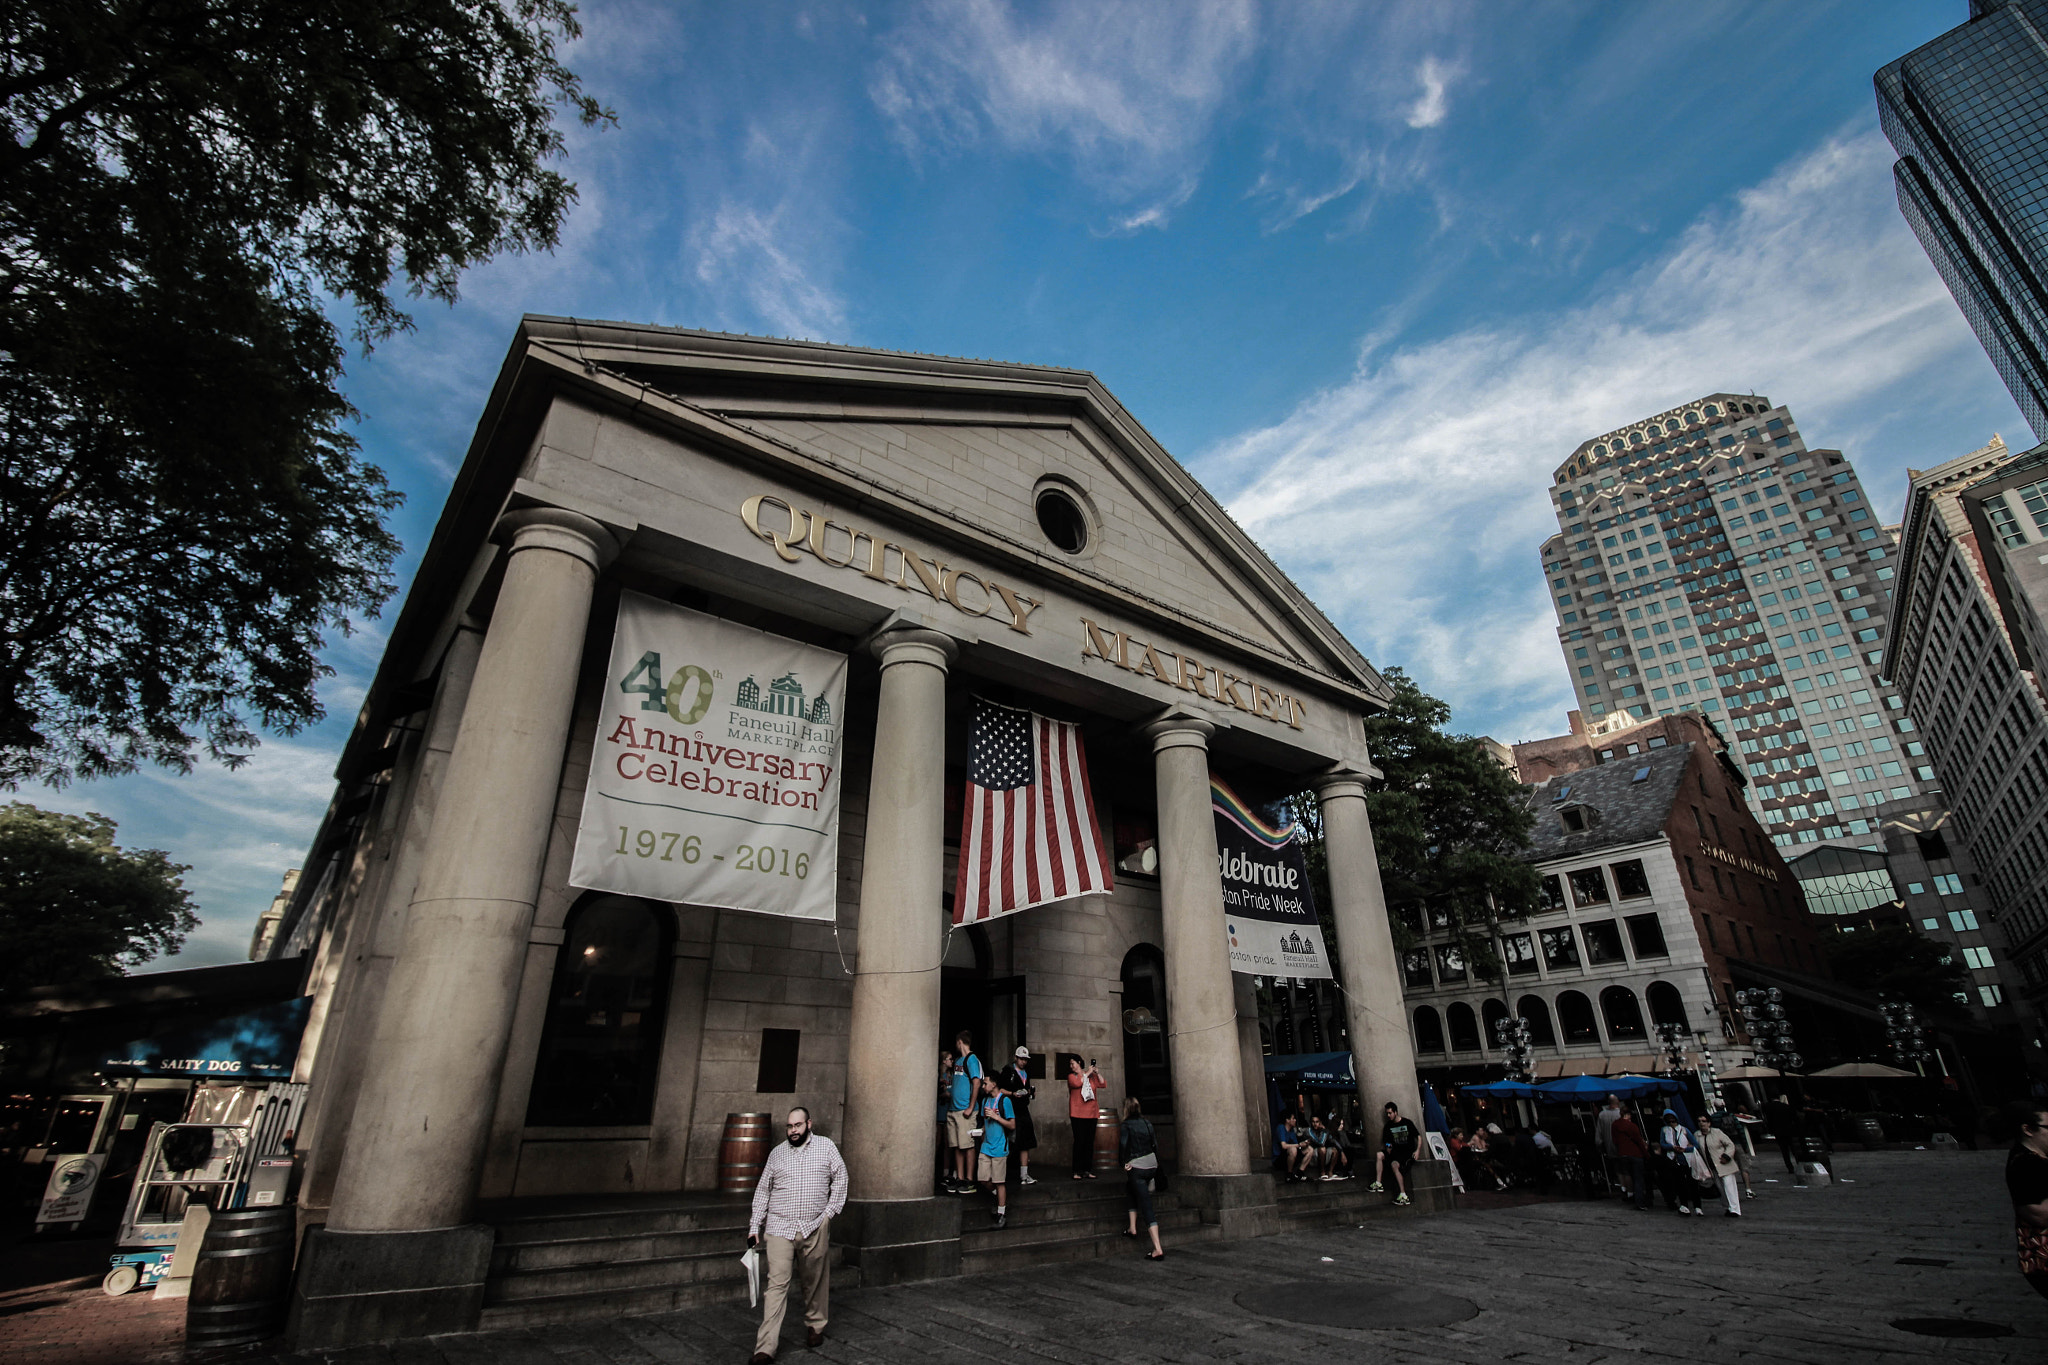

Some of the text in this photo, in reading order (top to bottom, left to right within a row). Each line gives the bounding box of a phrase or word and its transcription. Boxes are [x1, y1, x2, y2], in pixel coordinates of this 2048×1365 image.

[740, 495, 1308, 732] QUINCY MARKET
[727, 728, 834, 757] MARKETPLACE
[728, 711, 835, 744] Faneuil Hall
[607, 714, 834, 793] Anniversary
[616, 752, 820, 812] Celebration
[615, 825, 703, 865] 1976
[735, 844, 811, 881] 2016
[1223, 885, 1306, 915] ton Pride Week
[1283, 953, 1304, 962] Faneuil
[160, 1058, 205, 1070] SALTY
[207, 1060, 242, 1072] DOG
